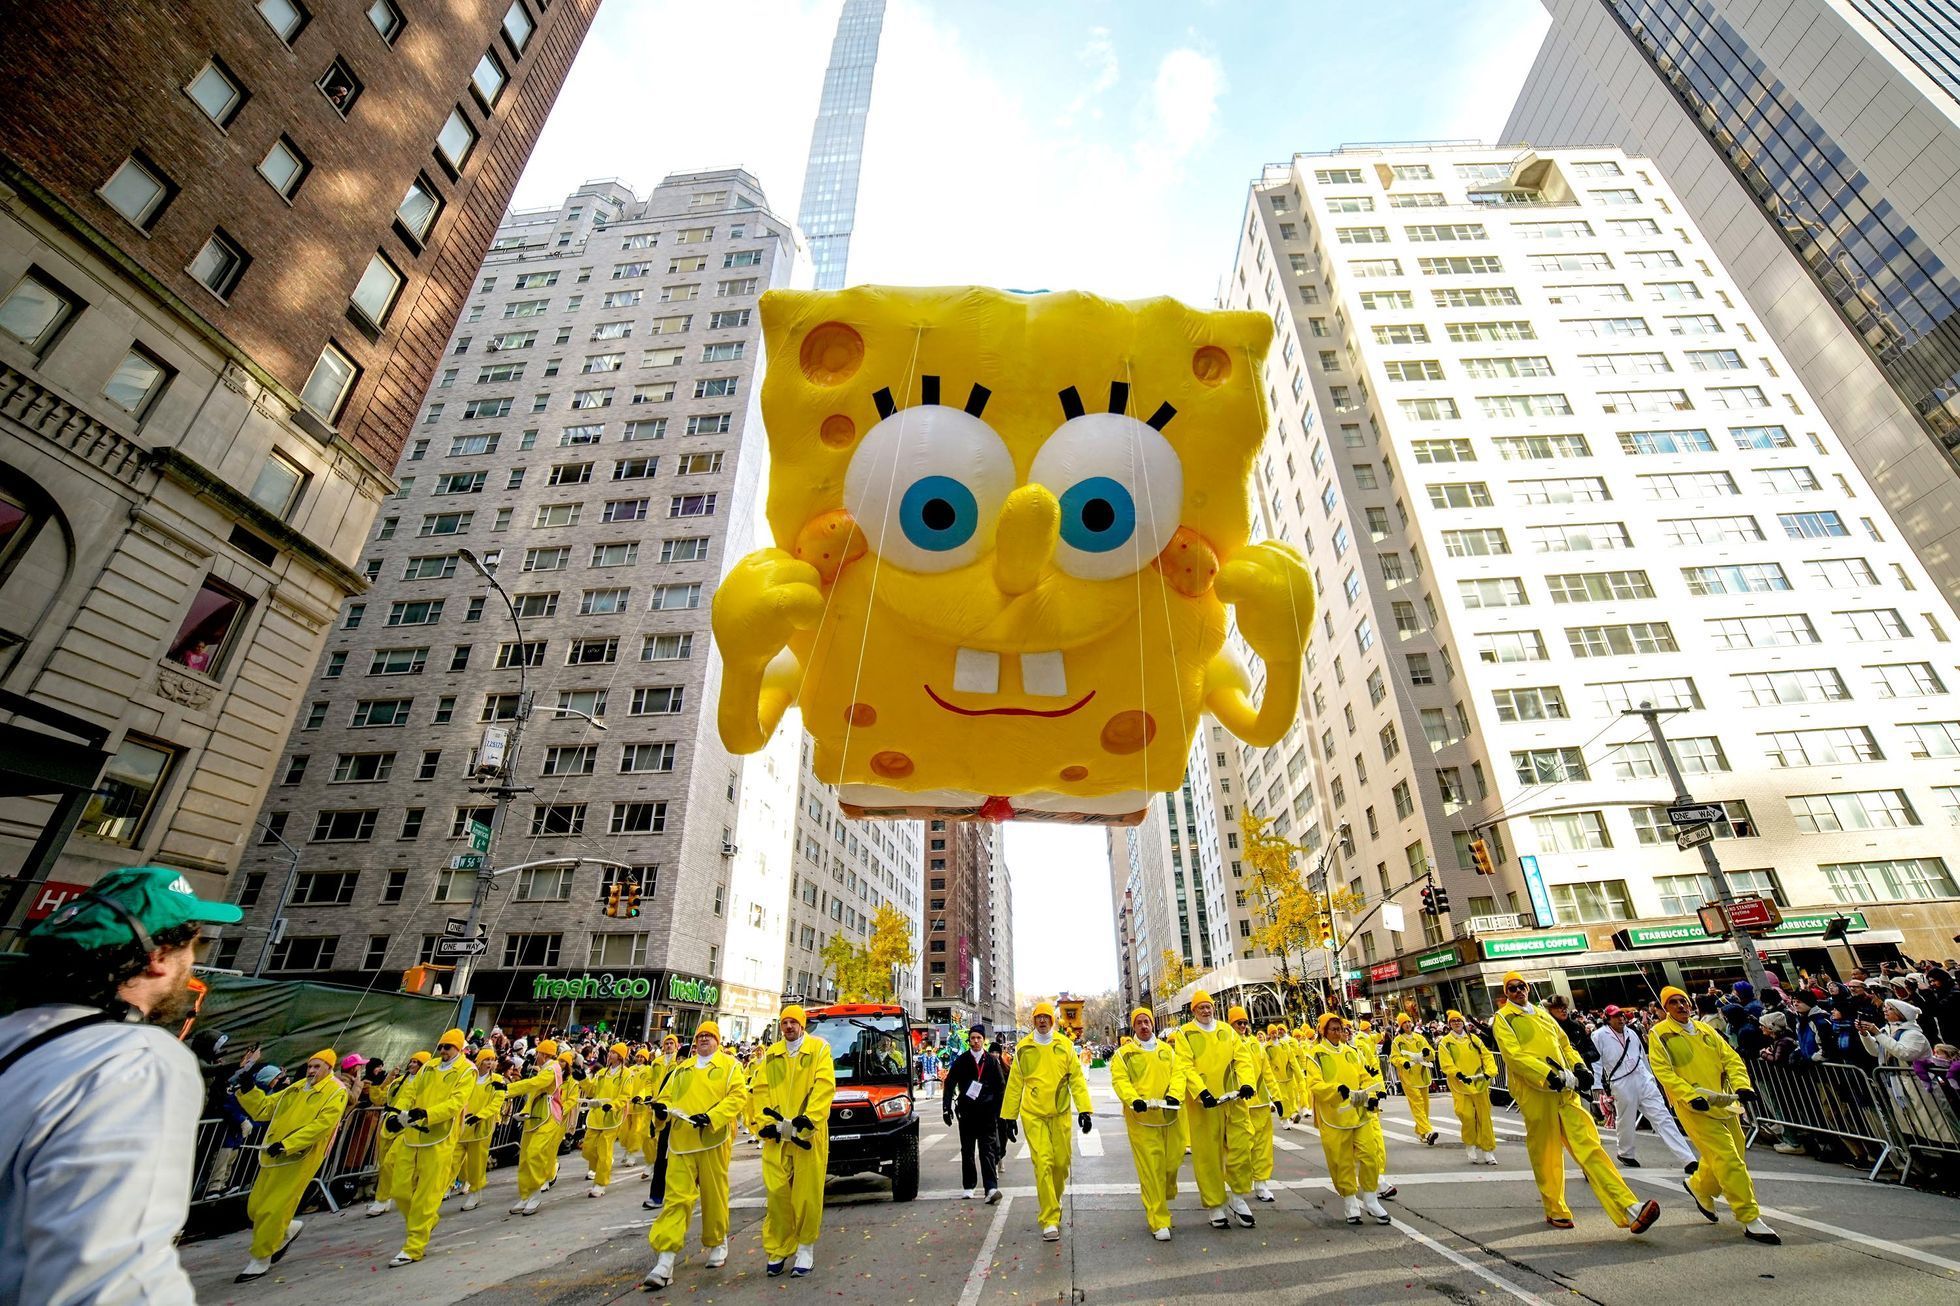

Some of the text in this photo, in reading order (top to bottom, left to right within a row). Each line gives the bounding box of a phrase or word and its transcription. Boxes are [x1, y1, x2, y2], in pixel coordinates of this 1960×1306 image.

[1673, 810, 1717, 820] ONE WAY
[1680, 828, 1708, 845] ONE WAY
[459, 858, 466, 867] W
[466, 857, 475, 867] 56
[450, 924, 462, 932] ONE
[1638, 928, 1689, 940] STARBUCKS
[443, 943, 457, 951] ONE
[1493, 937, 1579, 952] STARBUCKS COFFEE
[1420, 954, 1453, 968] STARBUCKS COFFEE
[533, 973, 650, 999] fresh&co
[669, 974, 718, 1005] fresh&co
